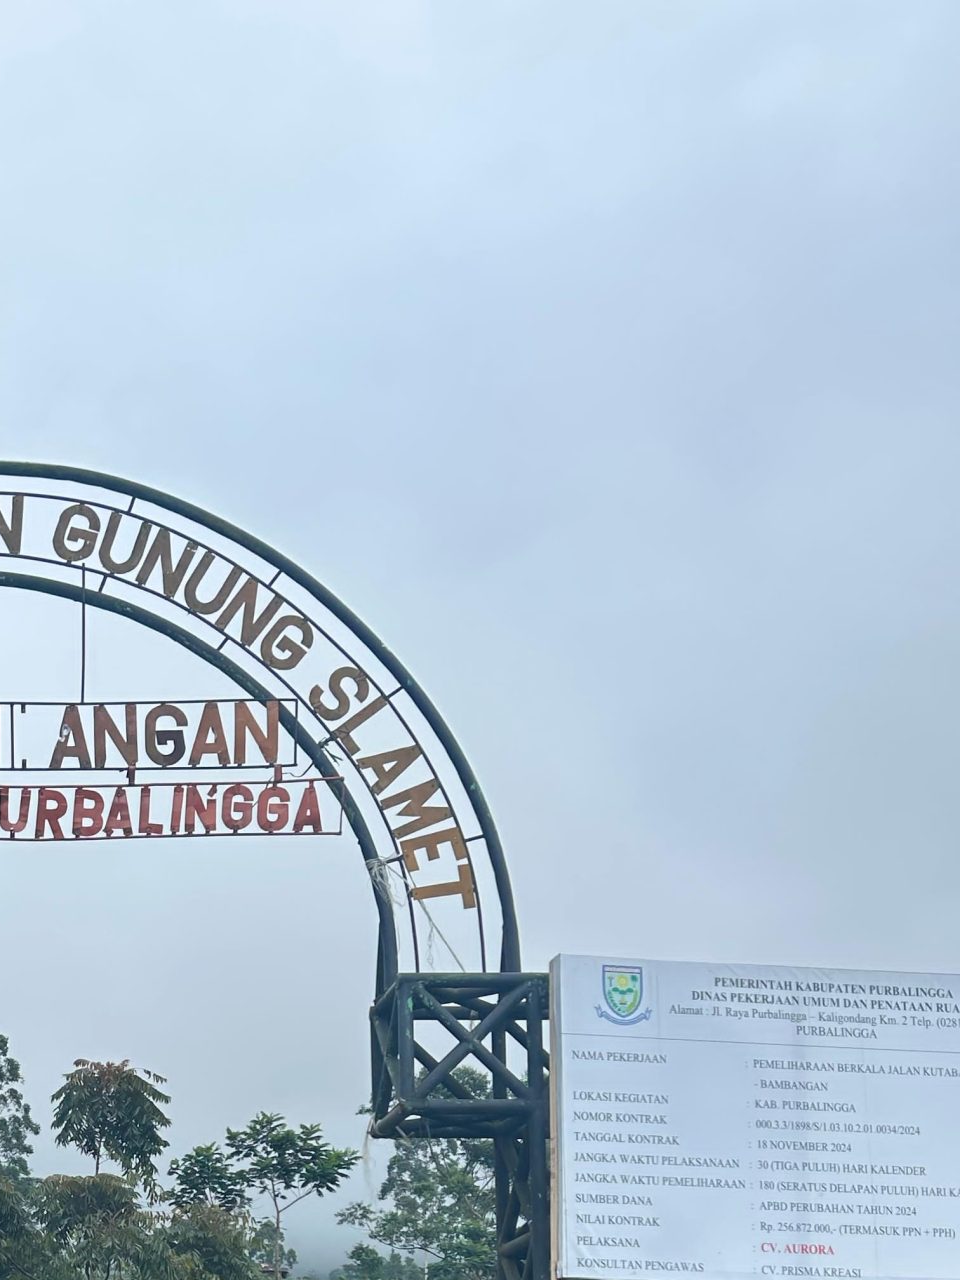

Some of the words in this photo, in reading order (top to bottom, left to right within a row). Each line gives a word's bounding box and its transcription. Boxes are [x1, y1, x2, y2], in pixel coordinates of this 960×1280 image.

[52, 504, 313, 671] GUNUNG
[309, 666, 477, 909] SLAMET
[714, 977, 792, 991] PEMERINTAH
[796, 981, 866, 995] KABUPATEN
[869, 984, 953, 999] PURBALINGGA
[692, 990, 728, 1001] DINAS
[730, 992, 799, 1006] PEKERJAAN
[803, 996, 840, 1008] UMUM
[843, 998, 868, 1009] DAN
[871, 999, 933, 1012] PENATAAN
[669, 1004, 703, 1016] Alamat
[725, 1007, 749, 1020] Raya
[752, 1008, 807, 1022] Purbalingga
[818, 1011, 877, 1026] Kaligondang
[901, 1016, 908, 1026] 2
[796, 1025, 878, 1039] PURBALINGGA
[572, 1050, 604, 1061] NAMA
[606, 1052, 667, 1064] PEKERJAAN
[753, 1059, 835, 1072] PEMELIHARAAN
[837, 1062, 886, 1074] BERKALA
[888, 1065, 920, 1076] JALAN
[923, 1066, 960, 1077] KUTAB
[760, 1079, 829, 1092] BAMBANGAN
[573, 1091, 612, 1102] LOKASI
[614, 1092, 669, 1105] KEGIATAN
[782, 1100, 857, 1113] PURBALINGGA
[573, 1111, 613, 1122] NOMOR
[615, 1113, 668, 1125] KONTRAK
[574, 1131, 625, 1143] TANGGAL
[627, 1133, 680, 1146] KONTRAK
[757, 1139, 768, 1150] 18
[770, 1140, 829, 1152] NOVEMBER
[830, 1142, 852, 1153] 2024
[574, 1152, 617, 1164] JANGKA
[620, 1154, 659, 1166] WAKTU
[661, 1156, 740, 1168] PELAKSANAAN
[757, 1159, 769, 1170] 30
[770, 1160, 800, 1172] (TIGA
[801, 1162, 840, 1174] PULUH)
[842, 1163, 868, 1174] HARI
[870, 1164, 927, 1176] KALENDER
[575, 1172, 617, 1184] JANGKA
[620, 1174, 660, 1186] WAKTU
[662, 1176, 746, 1189] PEMELIHARAAN
[759, 1180, 775, 1190] 180
[777, 1181, 827, 1193] (SERATUS
[829, 1183, 878, 1195] DELAPAN
[880, 1185, 919, 1197] PULUH)
[921, 1186, 947, 1197] HARI
[575, 1193, 620, 1205] SUMBER
[622, 1195, 653, 1206] DANA
[759, 1201, 788, 1211] APBD
[790, 1202, 854, 1214] PERUBAHAN
[856, 1205, 893, 1216] TAHUN
[895, 1206, 917, 1217] 2024
[576, 1213, 605, 1225] NILAI
[607, 1215, 660, 1227] KONTRAK
[839, 1224, 901, 1237] (TERMASUK
[902, 1226, 921, 1237] PPN
[932, 1228, 956, 1239] PPH)
[576, 1235, 640, 1248] PELAKSANA
[761, 1242, 781, 1254] CV.
[784, 1243, 835, 1256] AURORA
[576, 1257, 642, 1270] KONSULTAN
[645, 1259, 704, 1272] PENGAWAS
[782, 1266, 821, 1277] PRISMA
[823, 1267, 862, 1279] KREASI
